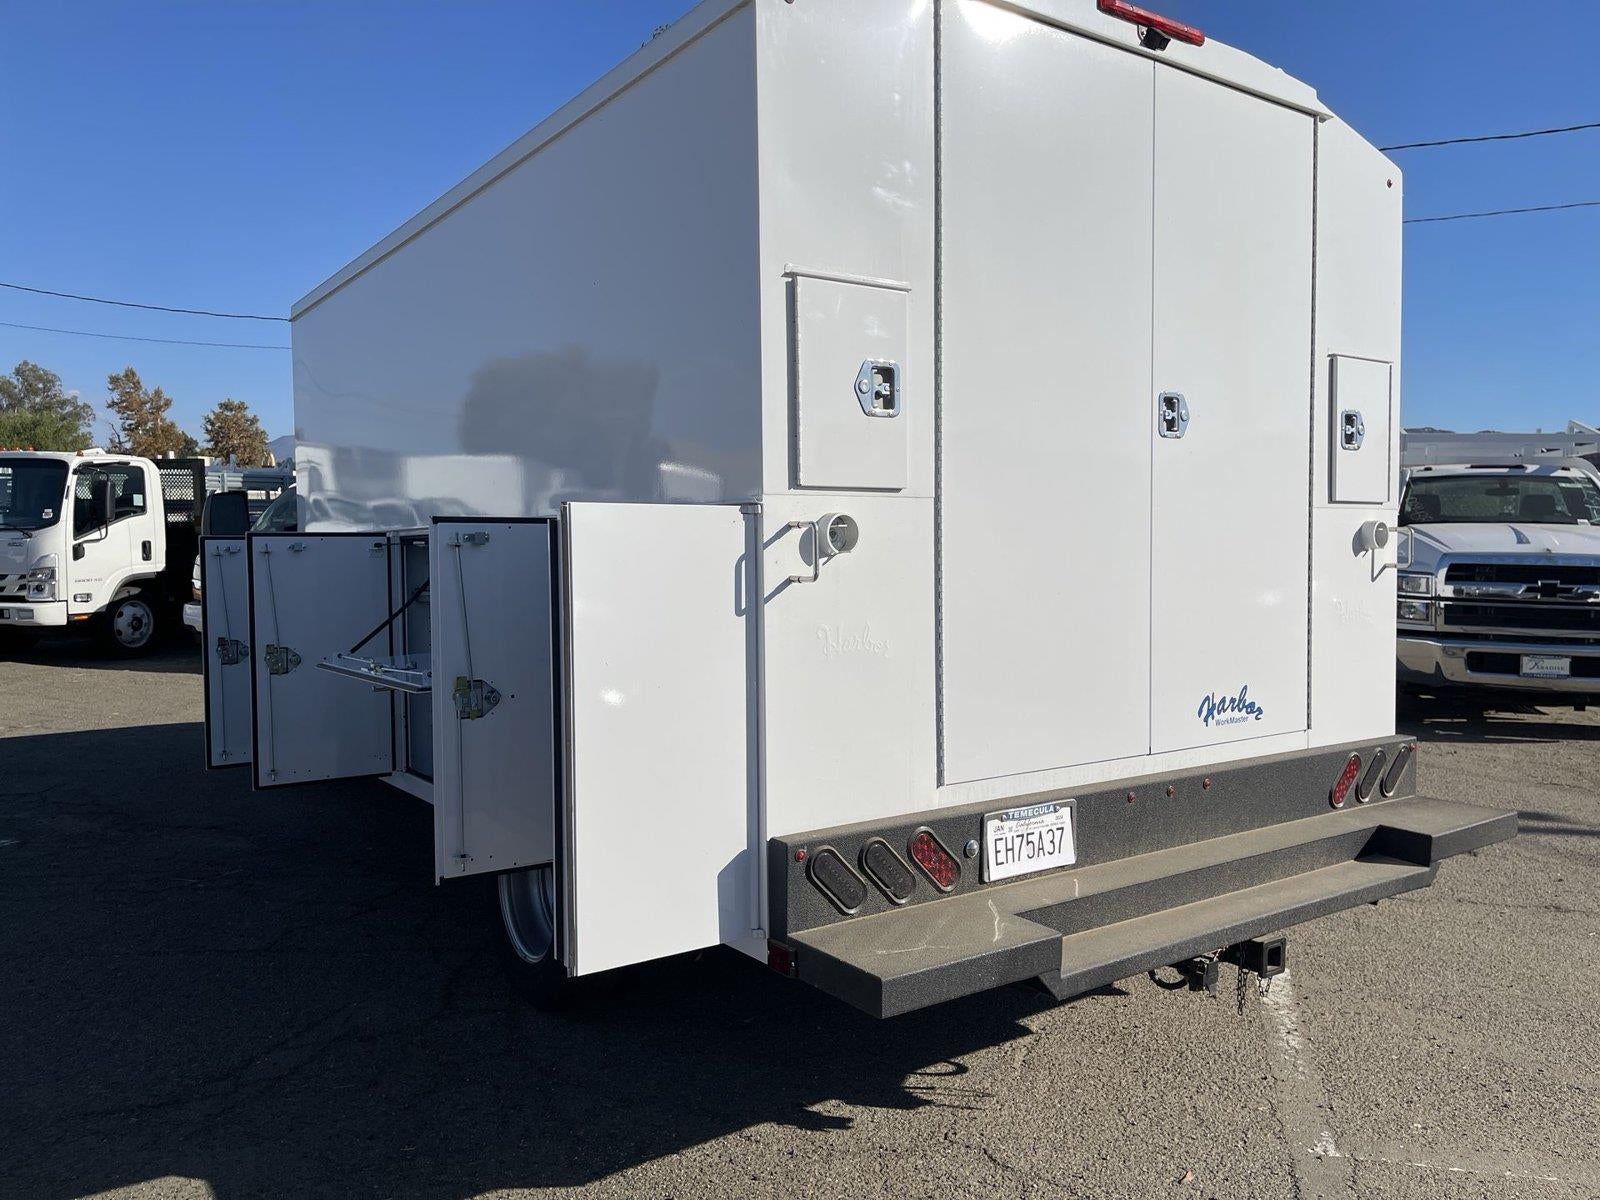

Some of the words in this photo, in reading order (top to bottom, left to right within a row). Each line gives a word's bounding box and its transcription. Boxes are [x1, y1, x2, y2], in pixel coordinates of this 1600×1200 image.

[1198, 685, 1263, 727] Harbor
[1008, 805, 1054, 819] TEMECULA
[993, 824, 1005, 833] JAN
[994, 827, 1064, 866] EH75A37
